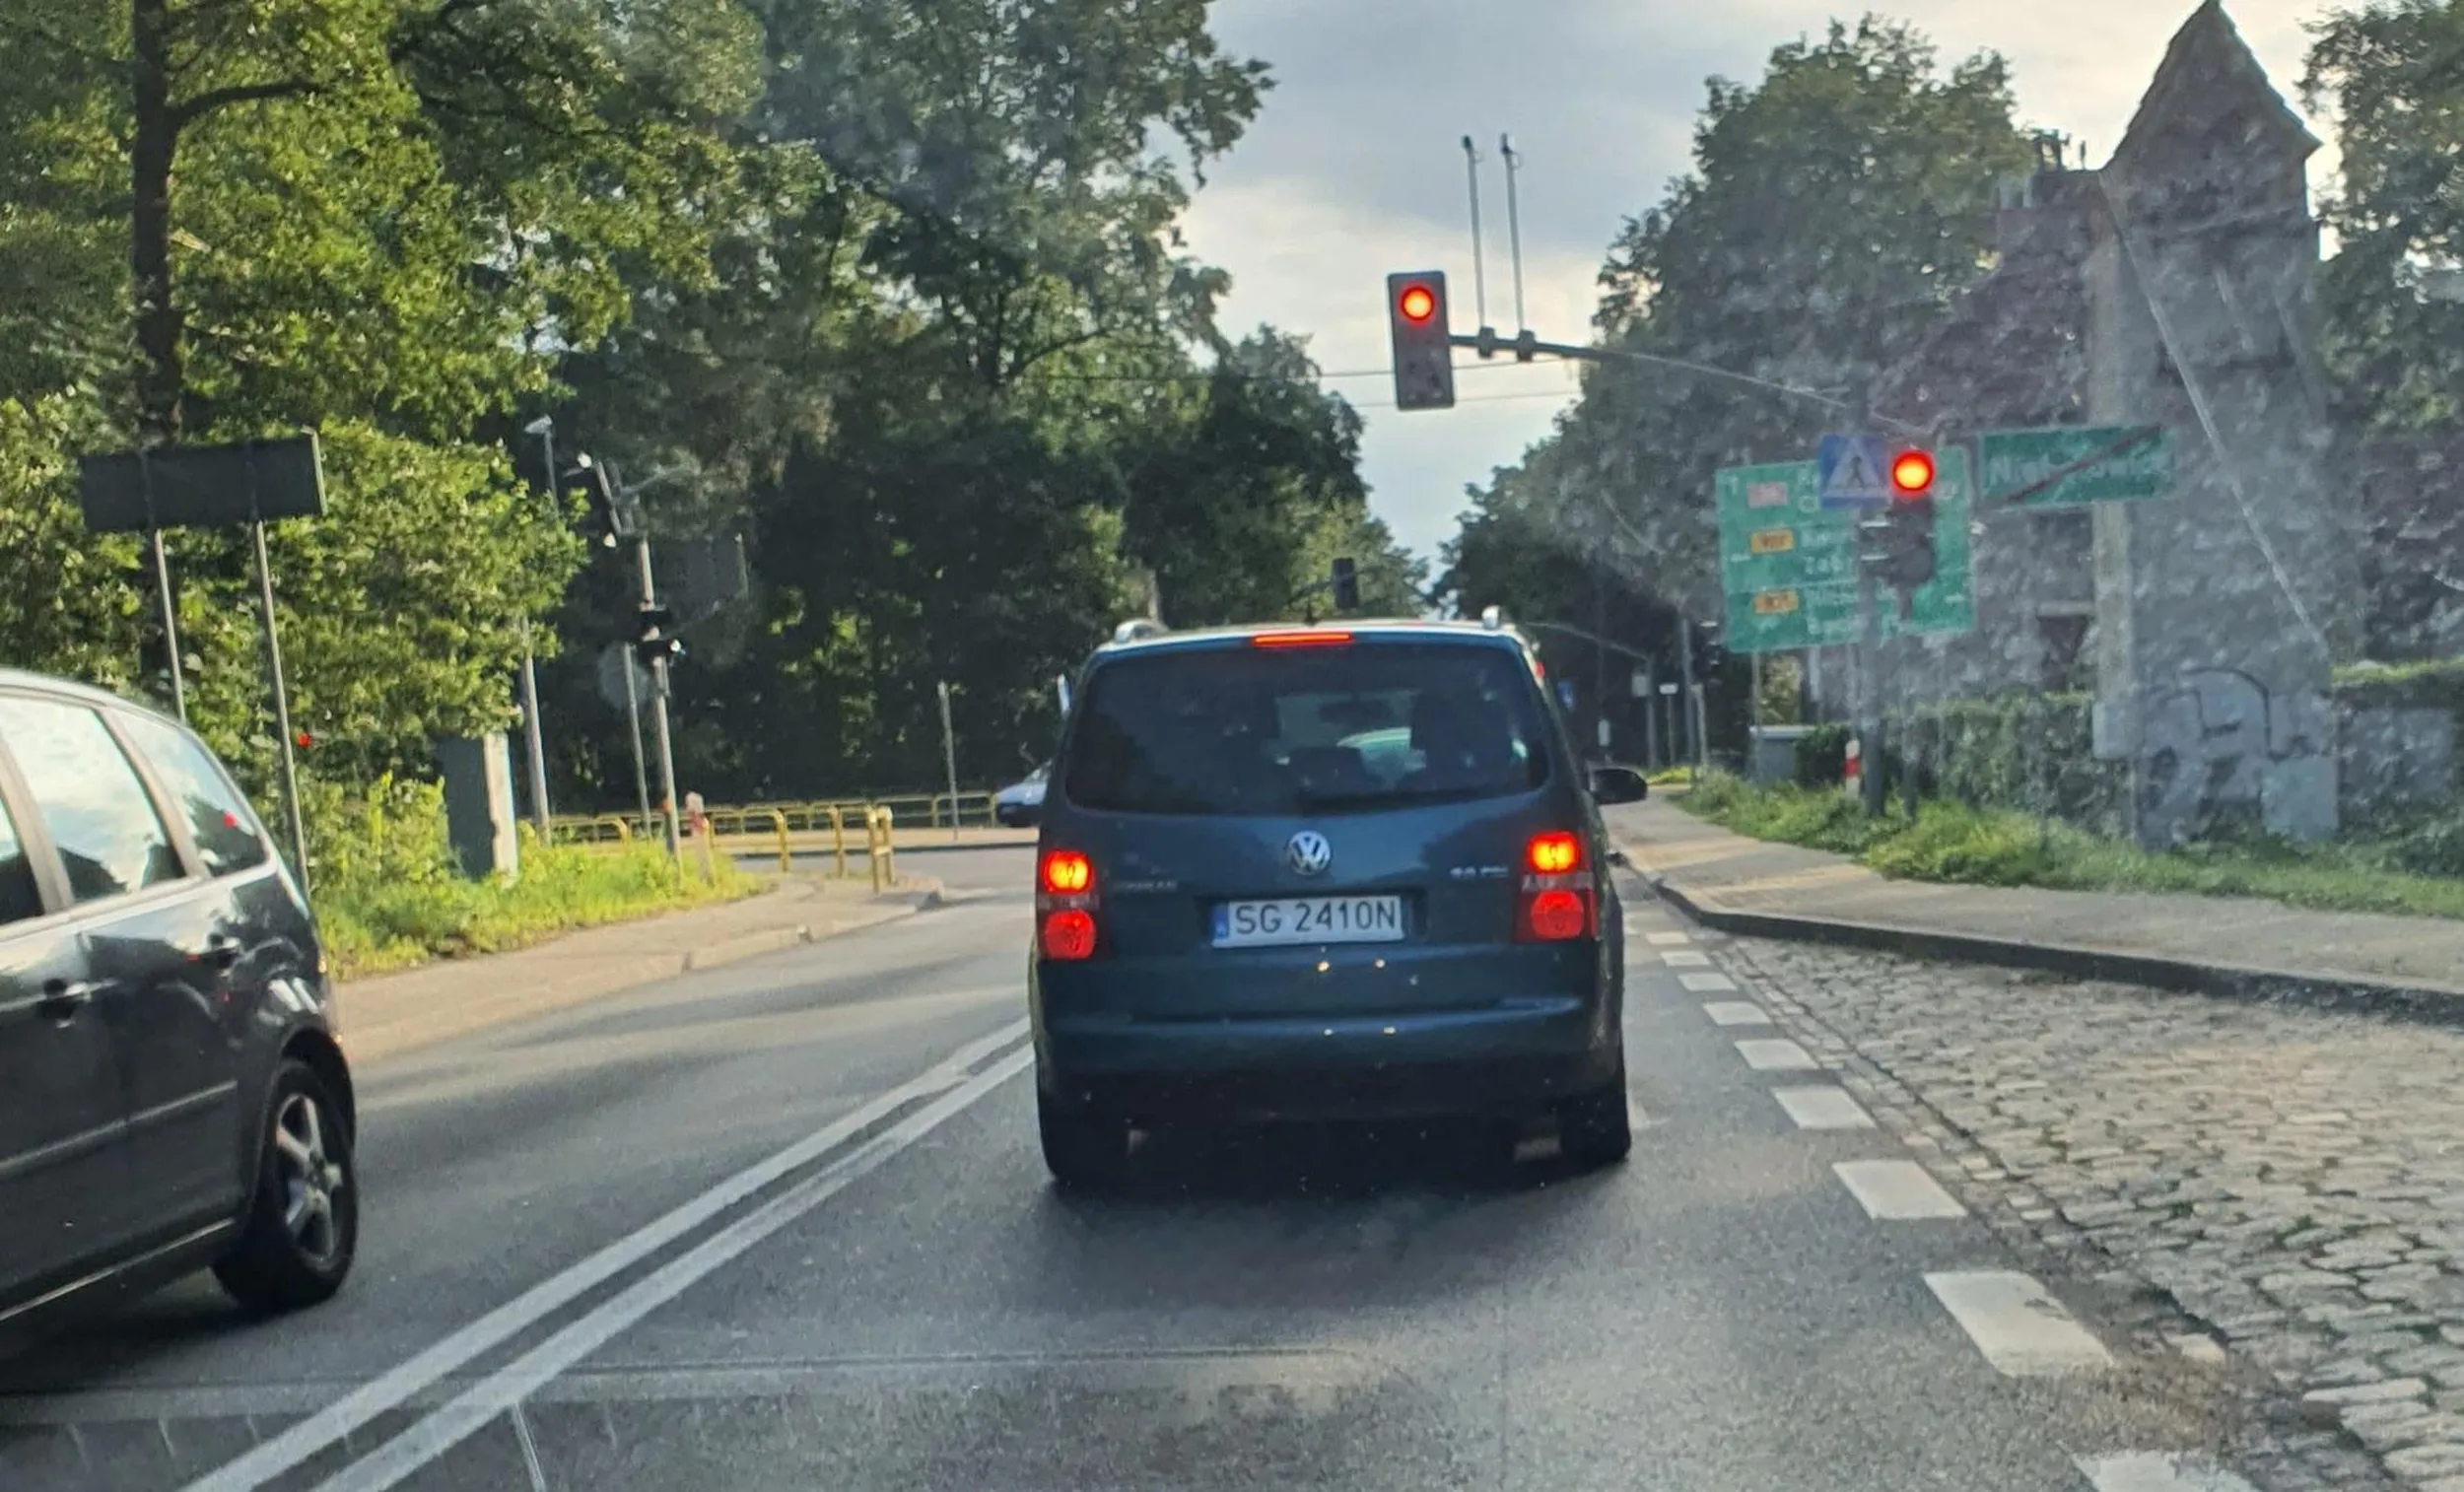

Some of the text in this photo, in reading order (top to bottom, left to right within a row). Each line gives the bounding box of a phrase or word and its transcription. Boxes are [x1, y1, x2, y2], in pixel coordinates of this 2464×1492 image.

[1288, 831, 1331, 875] VW
[1235, 901, 1396, 935] SG 2410N
